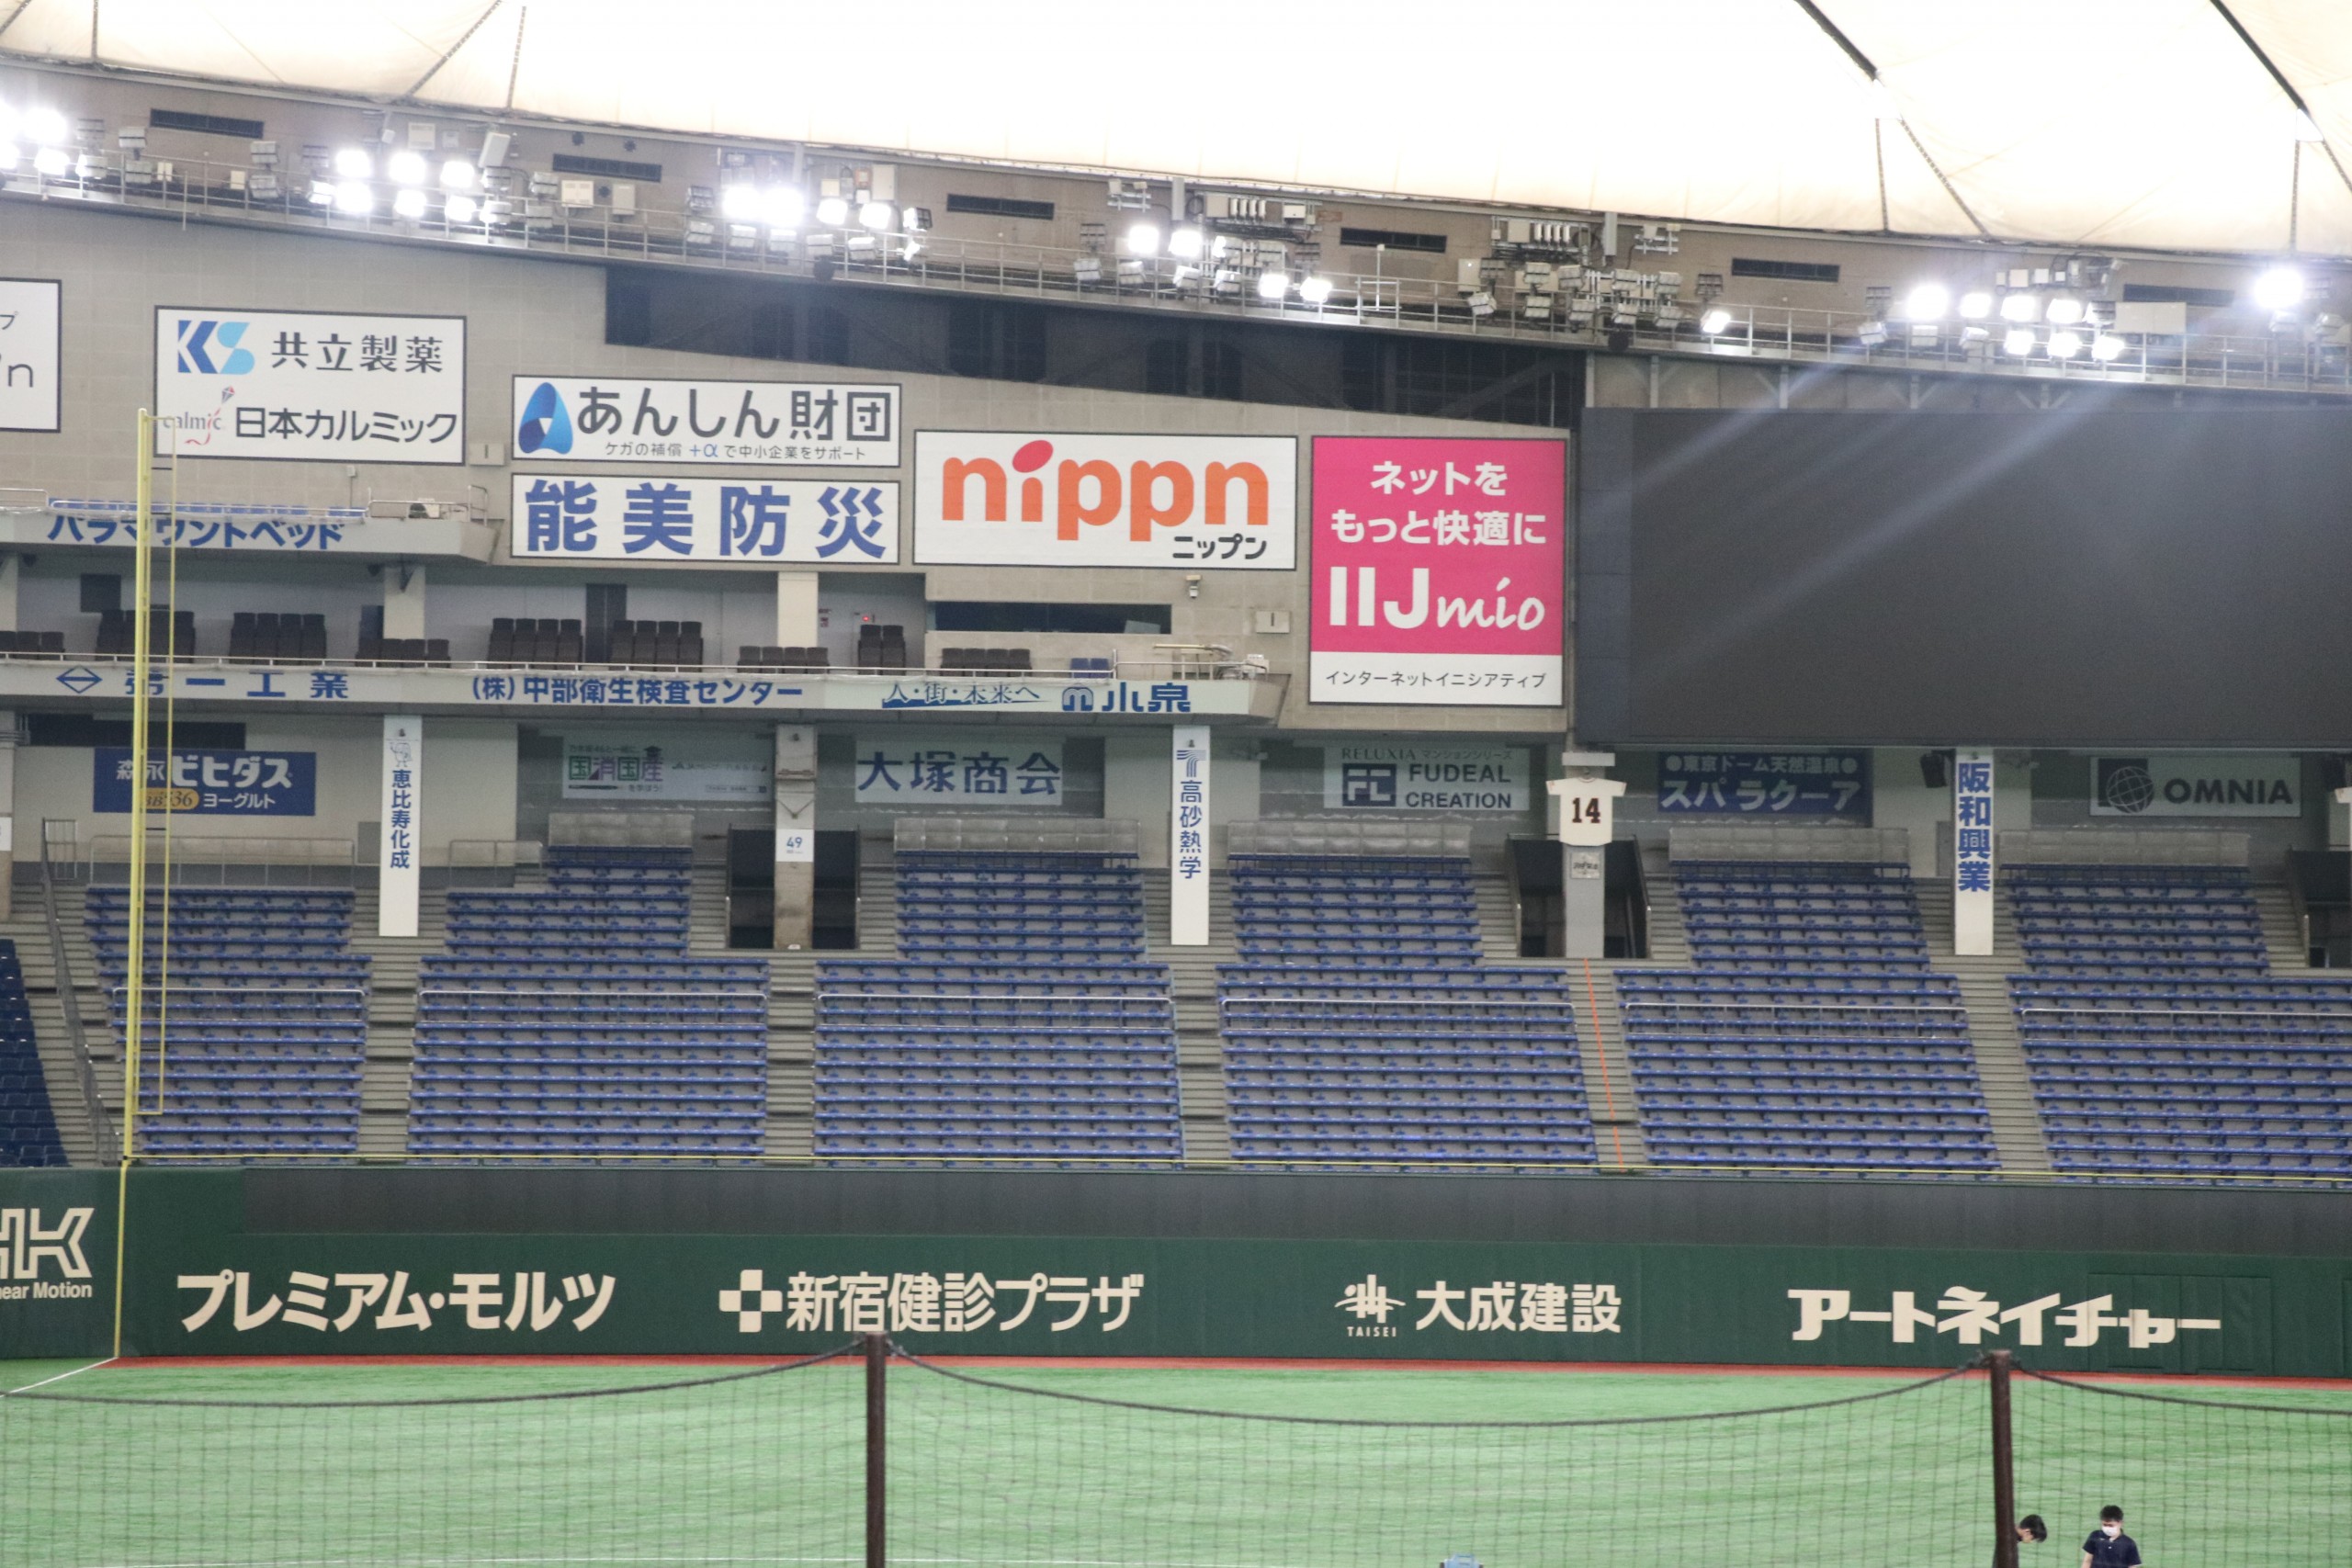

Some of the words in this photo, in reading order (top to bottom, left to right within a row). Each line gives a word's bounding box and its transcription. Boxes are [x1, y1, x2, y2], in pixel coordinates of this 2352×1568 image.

[271, 332, 444, 374] 共立製薬
[235, 407, 458, 444] 日本カルミック
[577, 386, 891, 442] あんしん財団
[942, 440, 1269, 542] nippn
[1371, 460, 1508, 496] ネットを
[526, 479, 887, 558] 能美防災
[1331, 509, 1546, 546] もっと快適に
[1172, 533, 1268, 559] ニップン
[1102, 681, 1191, 713] 小泉
[1326, 671, 1547, 688] インターネットイニシアティブ
[856, 750, 1063, 796] 大塚商会
[1409, 763, 1512, 784] FUDEAL
[2164, 778, 2294, 805] OMNIA
[203, 793, 277, 809] ヨーグルト
[1406, 791, 1512, 808] CREATION
[1572, 797, 1600, 824] 14
[390, 769, 413, 870] 恵比寿化成
[1179, 780, 1203, 879] 高砂熱学
[1958, 762, 1992, 893] 阪和興業
[786, 837, 803, 849] 49
[0, 1285, 29, 1299] ear
[33, 1281, 93, 1298] Motion
[177, 1269, 616, 1332] プレミアム・モルツ
[786, 1270, 1145, 1332] 新宿健診プラザ
[1416, 1280, 1622, 1333] 大成建設
[1347, 1326, 1396, 1337] TAISEI
[1787, 1286, 2222, 1348] アートネイチャー
